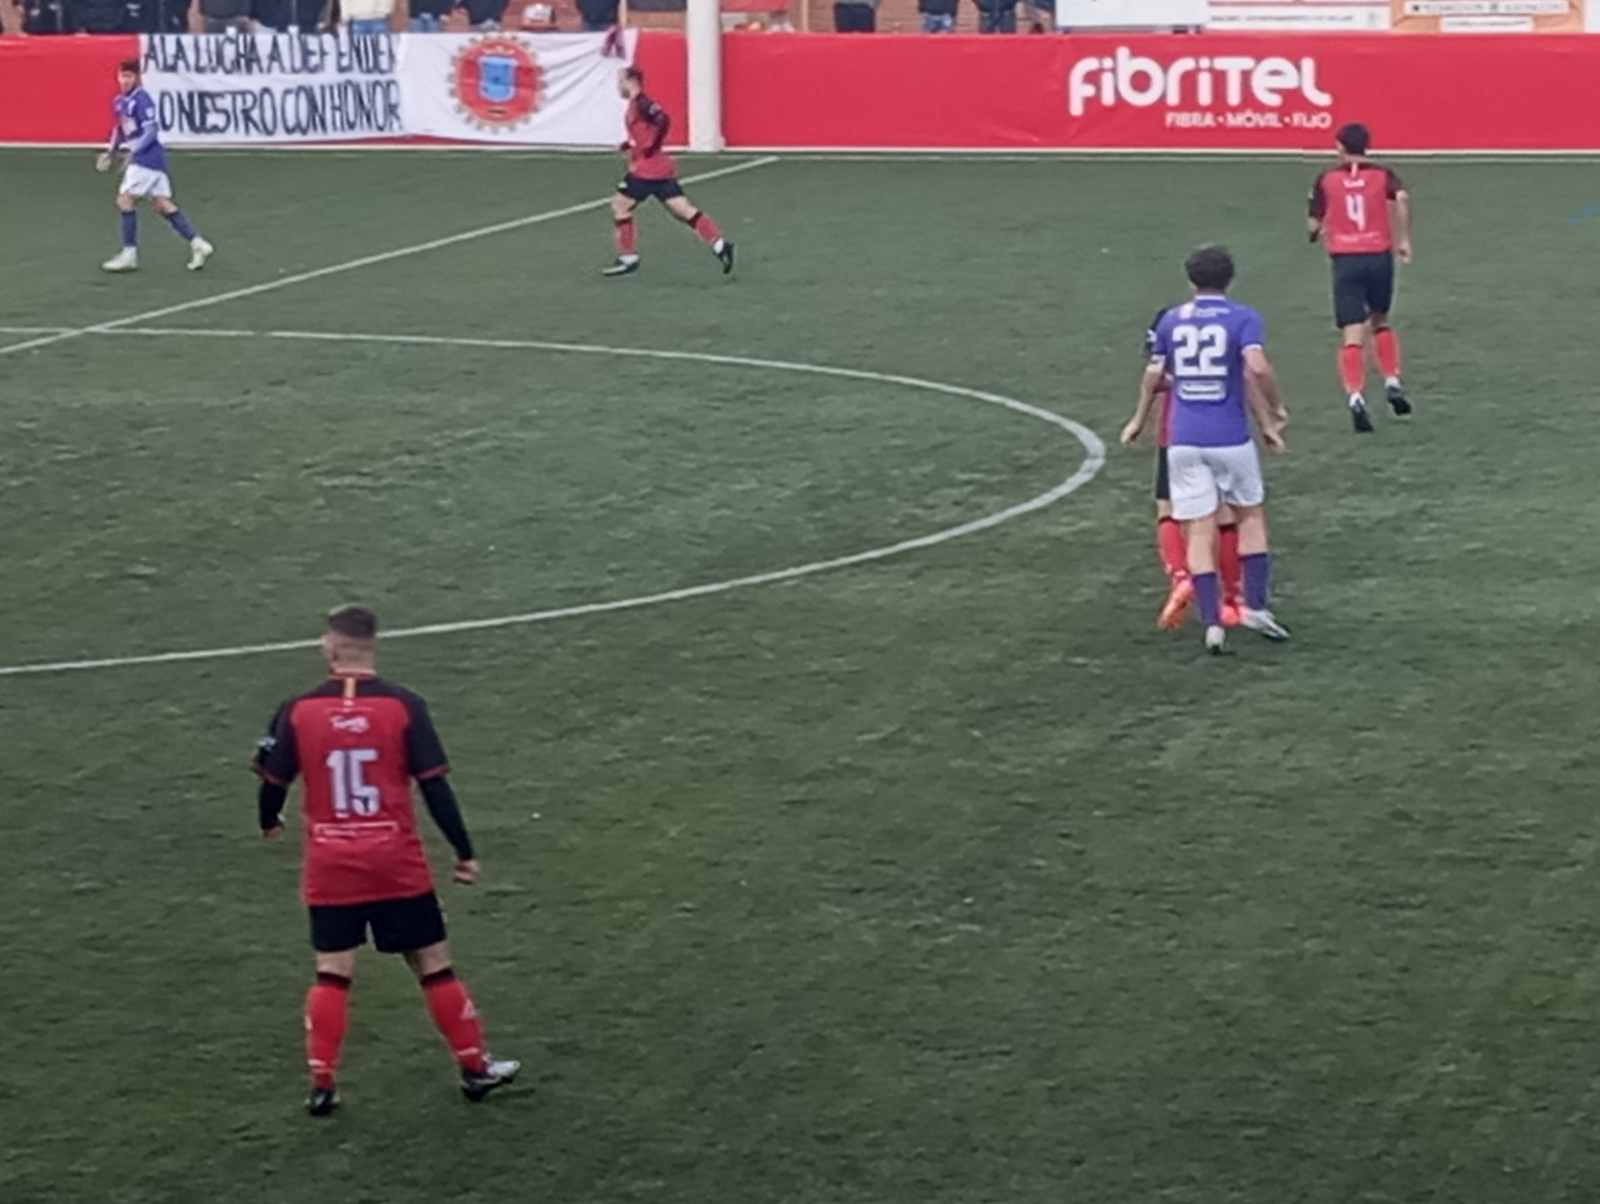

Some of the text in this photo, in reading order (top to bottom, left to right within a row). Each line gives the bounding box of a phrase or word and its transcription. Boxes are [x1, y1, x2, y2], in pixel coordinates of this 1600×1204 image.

[144, 34, 159, 74] A
[160, 34, 191, 73] LA
[194, 34, 264, 74] LUCHA
[267, 35, 286, 74] A
[159, 90, 175, 132] O
[281, 85, 328, 136] CON
[329, 79, 402, 132] HONOR
[1165, 111, 1216, 128] FIBRA
[1292, 111, 1332, 129] FIJO
[1345, 194, 1366, 232] 4
[1172, 324, 1229, 376] 22
[326, 748, 379, 818] 15
